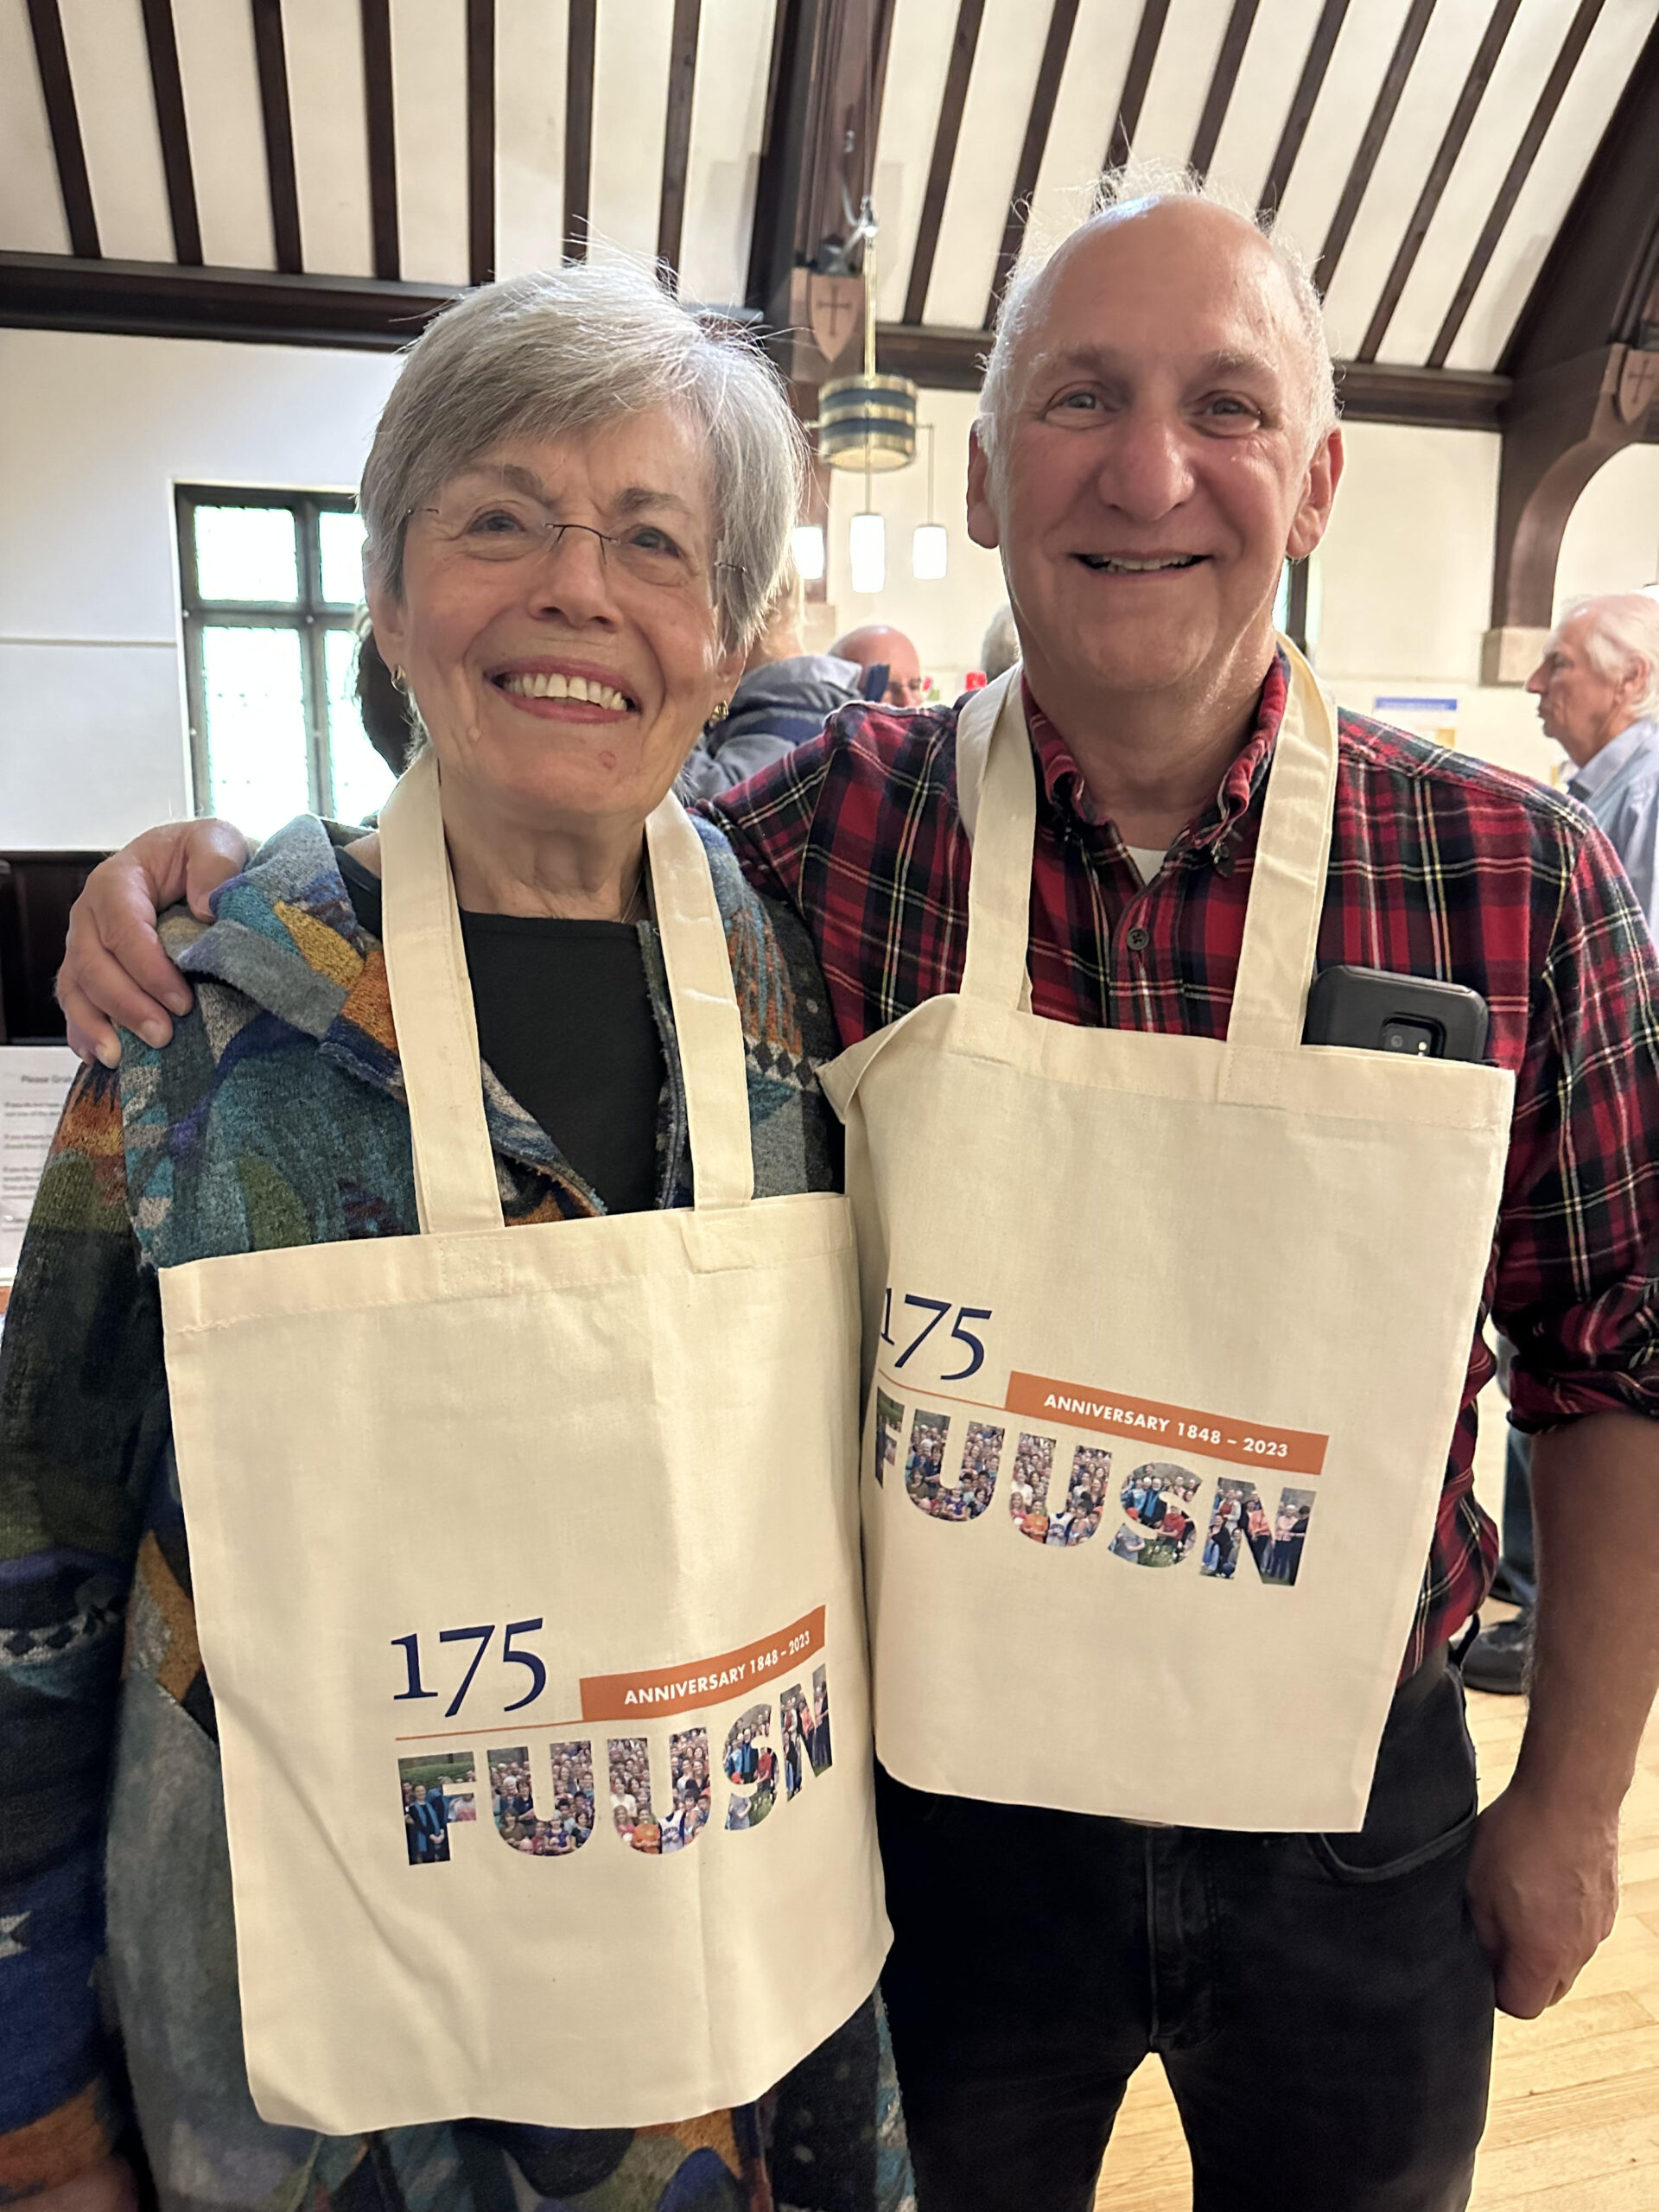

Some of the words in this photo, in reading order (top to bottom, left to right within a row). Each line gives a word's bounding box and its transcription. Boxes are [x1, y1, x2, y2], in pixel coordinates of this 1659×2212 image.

[880, 1287, 993, 1380] 175
[1044, 1394, 1170, 1432] ANNIVERSARY
[1177, 1422, 1221, 1444] 1848
[1243, 1437, 1287, 1457] 2023
[875, 1386, 1317, 1587] FUUSN
[391, 1618, 546, 1718] 175
[624, 1664, 746, 1705] ANNIVERSARY
[750, 1649, 778, 1674] 1848
[789, 1630, 810, 1656] 2023
[398, 1663, 833, 1866] FUUSN
